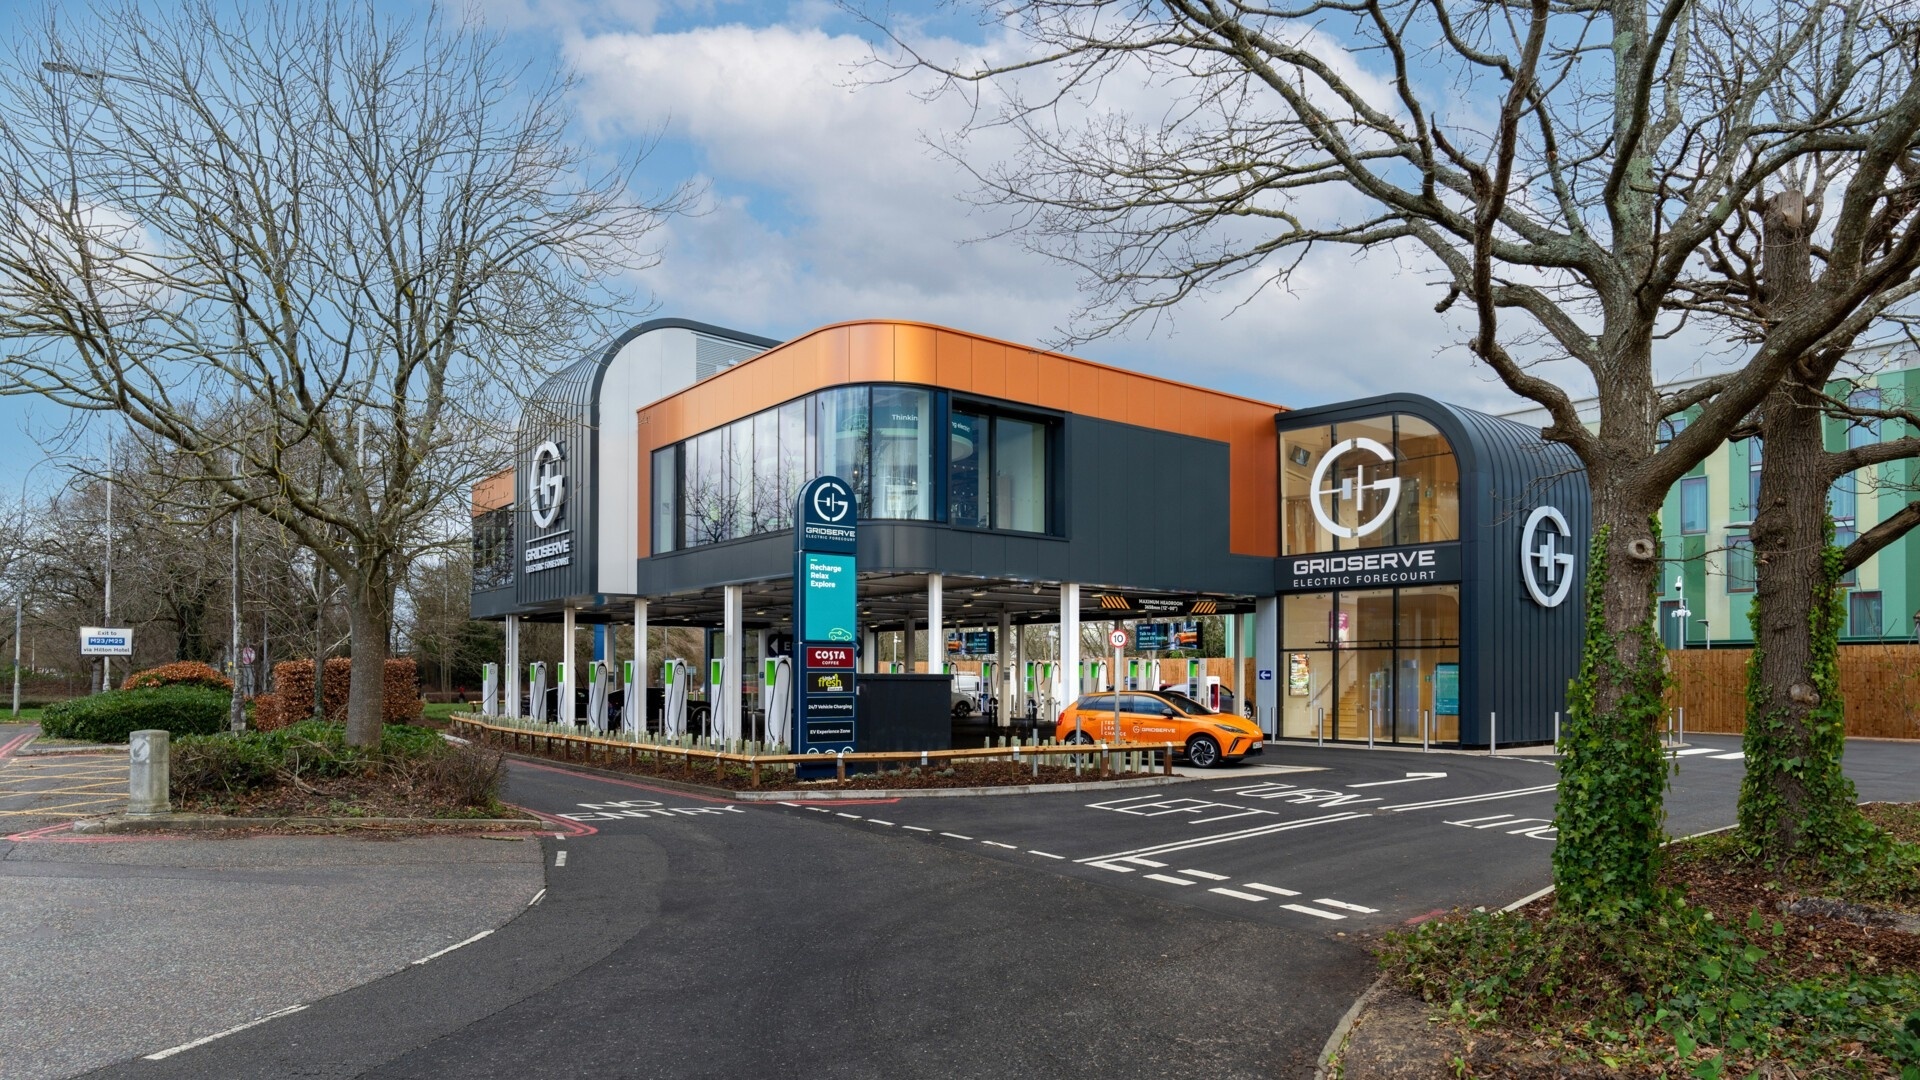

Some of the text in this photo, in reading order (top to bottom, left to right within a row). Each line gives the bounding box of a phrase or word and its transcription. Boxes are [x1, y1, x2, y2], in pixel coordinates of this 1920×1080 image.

[806, 526, 856, 538] GRIDSERVE
[526, 540, 570, 562] GRIDSERVE
[810, 564, 842, 573] Recharge
[1294, 550, 1436, 575] GRIDSERVE
[810, 580, 836, 588] Explore
[1294, 571, 1436, 588] ELECTRIC FORECOURT
[1114, 634, 1123, 643] 10
[815, 650, 846, 660] COSTA
[818, 674, 842, 687] fresh
[1212, 782, 1384, 808] TURN
[576, 800, 664, 810] NO
[1085, 794, 1279, 824] LEFT
[556, 805, 746, 821] ENTRY
